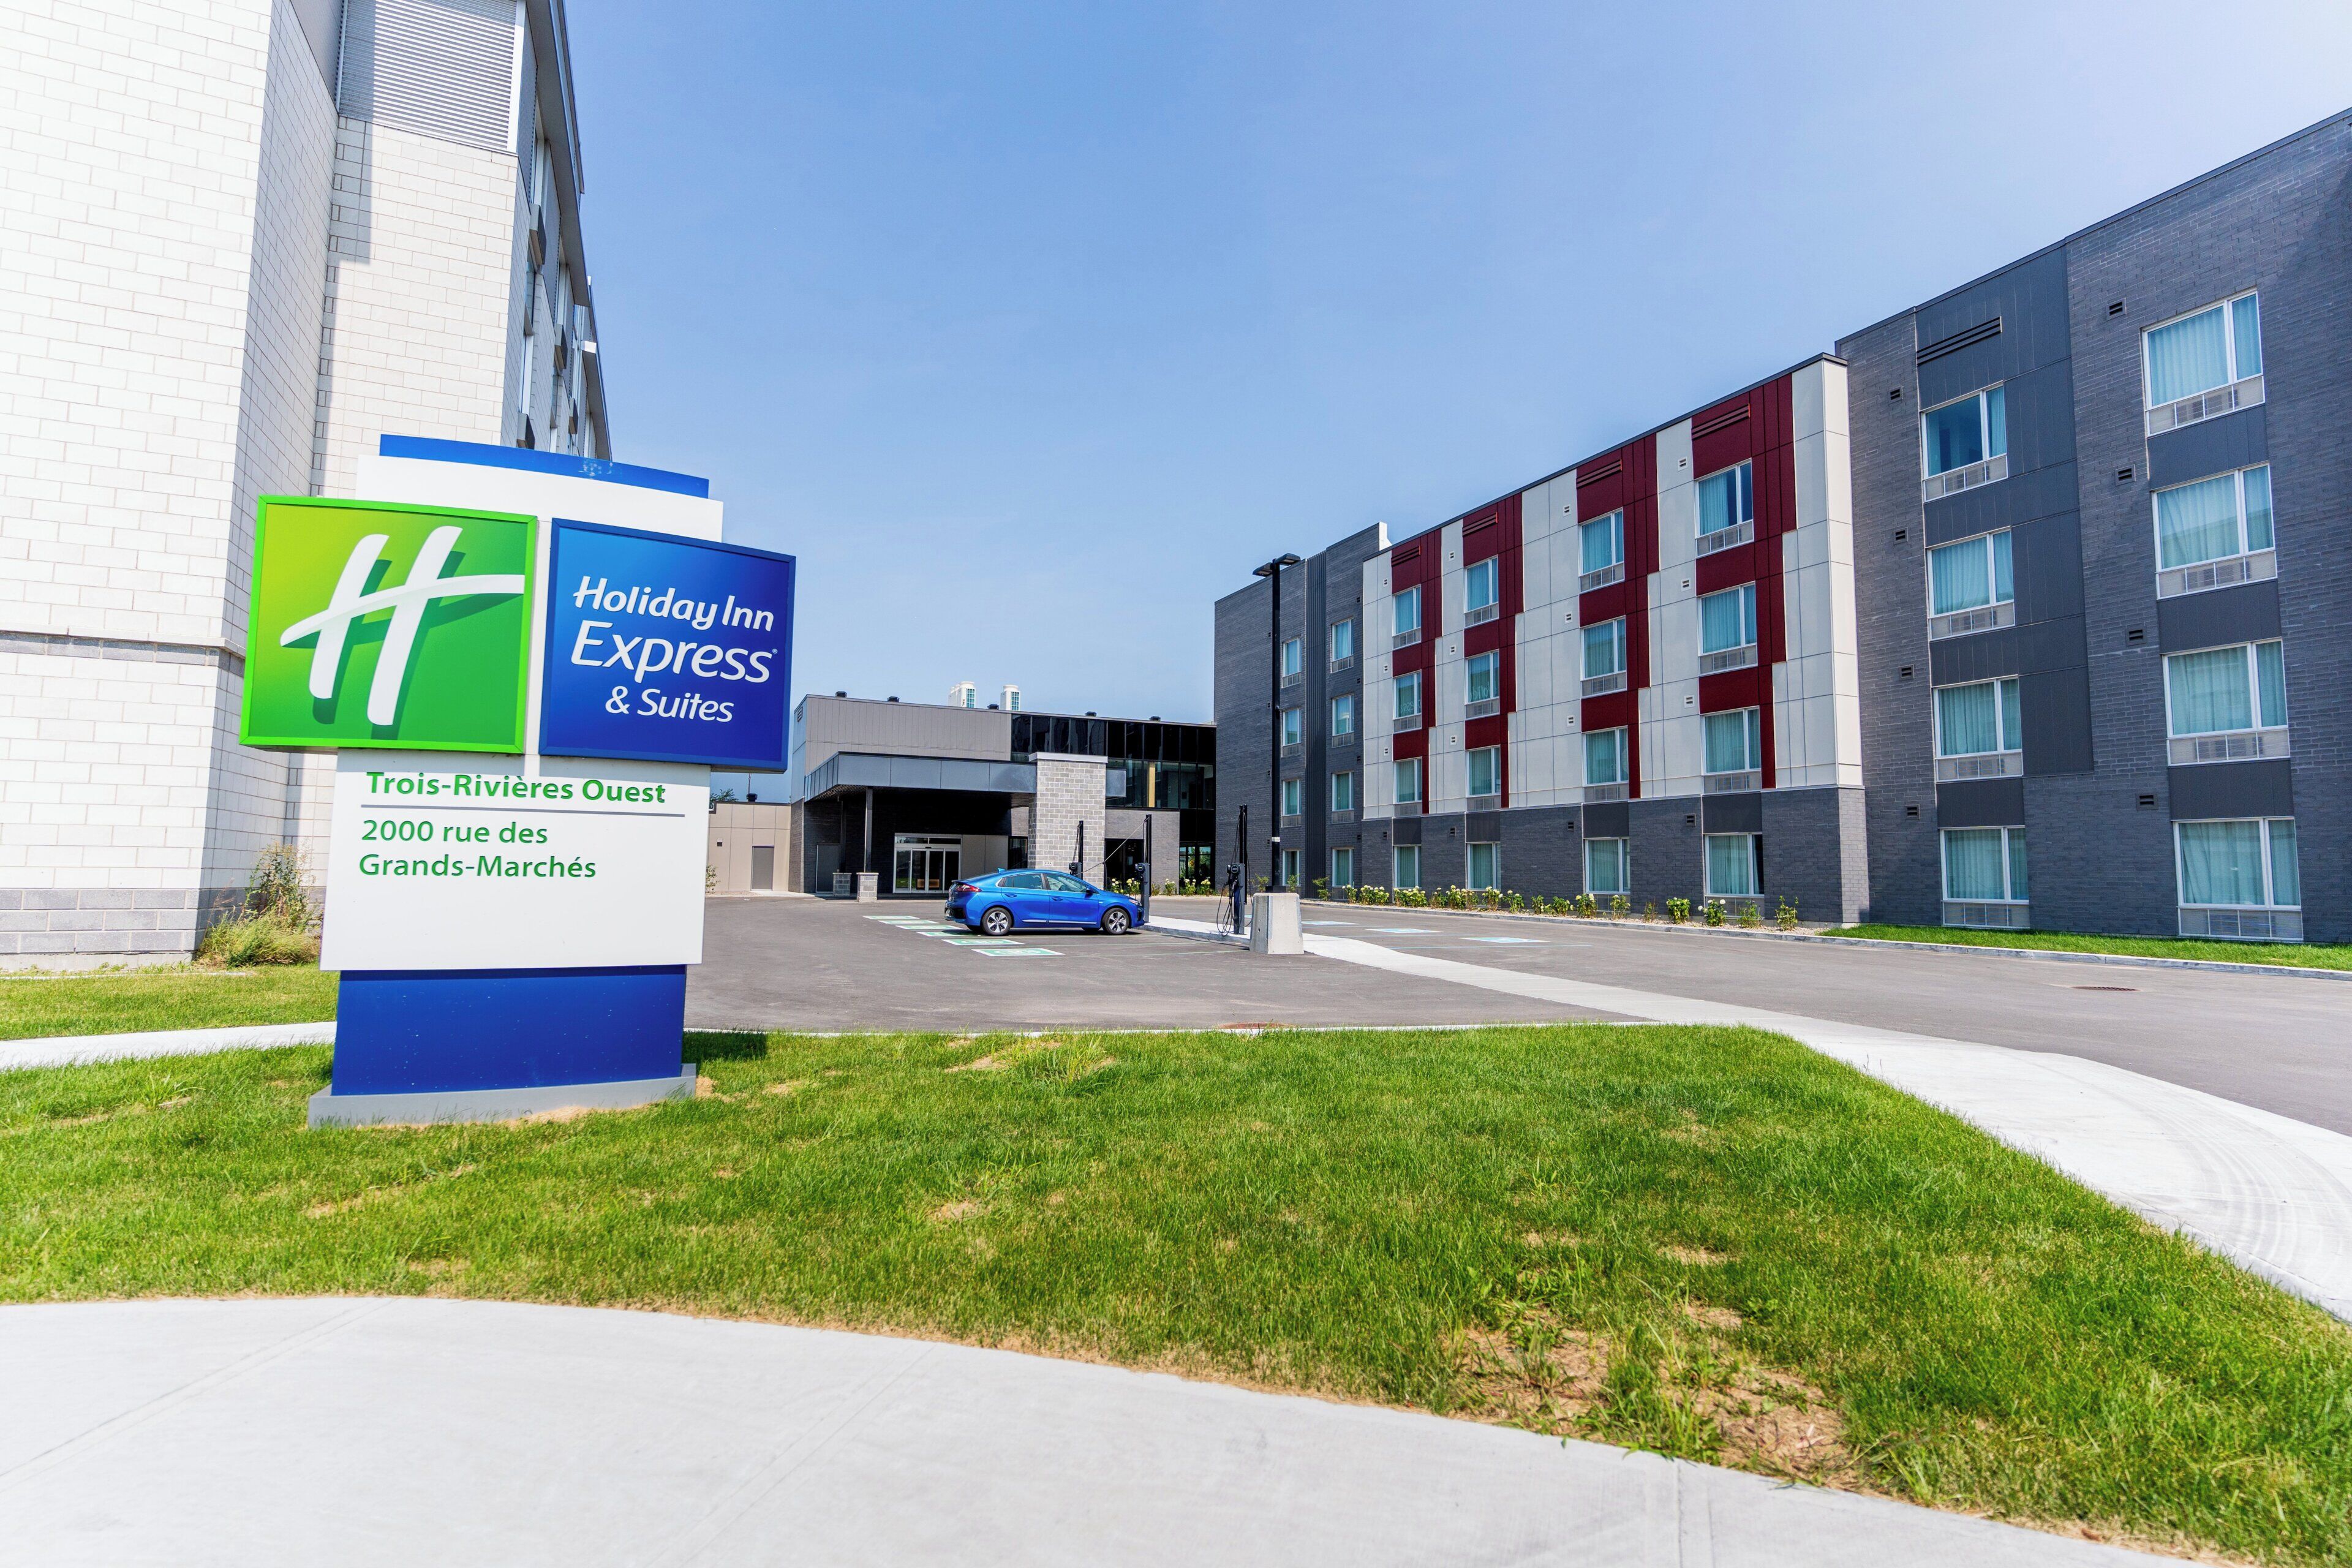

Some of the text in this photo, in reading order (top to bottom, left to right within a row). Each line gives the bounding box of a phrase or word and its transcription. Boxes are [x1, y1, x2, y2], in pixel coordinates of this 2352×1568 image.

[573, 576, 774, 632] Holiday Inn
[571, 620, 772, 684] Express
[605, 685, 734, 723] & Suites
[366, 771, 666, 804] Trois-Rivières Ouest
[361, 820, 548, 844] 2000 rue des
[359, 853, 596, 878] Grands-Marchés
